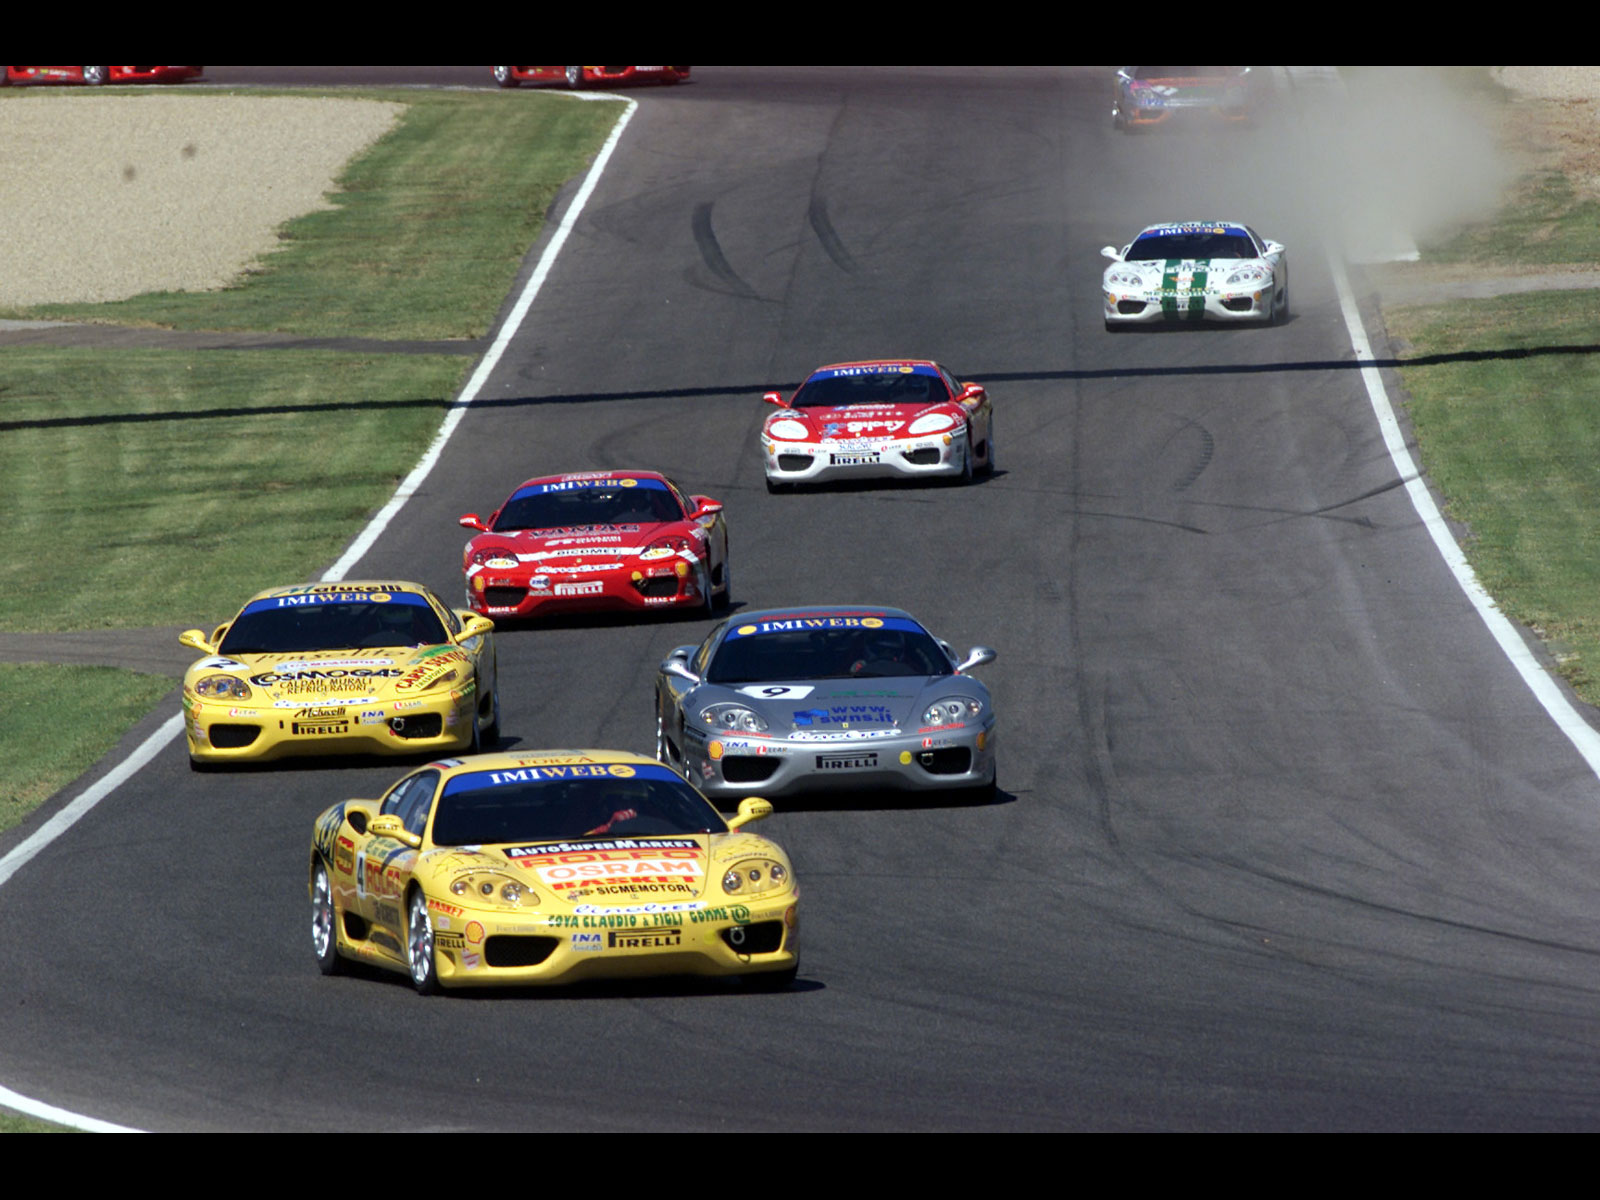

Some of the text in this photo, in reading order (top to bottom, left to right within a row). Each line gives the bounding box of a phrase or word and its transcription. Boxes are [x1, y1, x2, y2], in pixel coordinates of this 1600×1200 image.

[833, 366, 897, 377] IMIWEB
[830, 451, 880, 465] PIRELLI
[542, 479, 618, 493] IMIWEB
[553, 580, 604, 596] PIRELLI
[277, 592, 368, 607] IMIWEB
[762, 618, 859, 632] IMIWEB
[762, 686, 791, 698] 9
[361, 710, 385, 718] INA
[291, 720, 349, 735] PIRELLI
[815, 752, 878, 769] PIRELLI
[489, 764, 608, 785] IMIWEB
[520, 850, 700, 868] ROLFO
[546, 861, 696, 880] OSRAM
[596, 884, 692, 896] SICMEMOTORI
[429, 899, 464, 918] BASKET
[583, 914, 637, 929] CLAUDIO
[653, 913, 683, 928] FIGLI
[434, 930, 466, 949] PIRELLI
[571, 933, 603, 943] INA
[607, 929, 682, 949] PIRELLI
